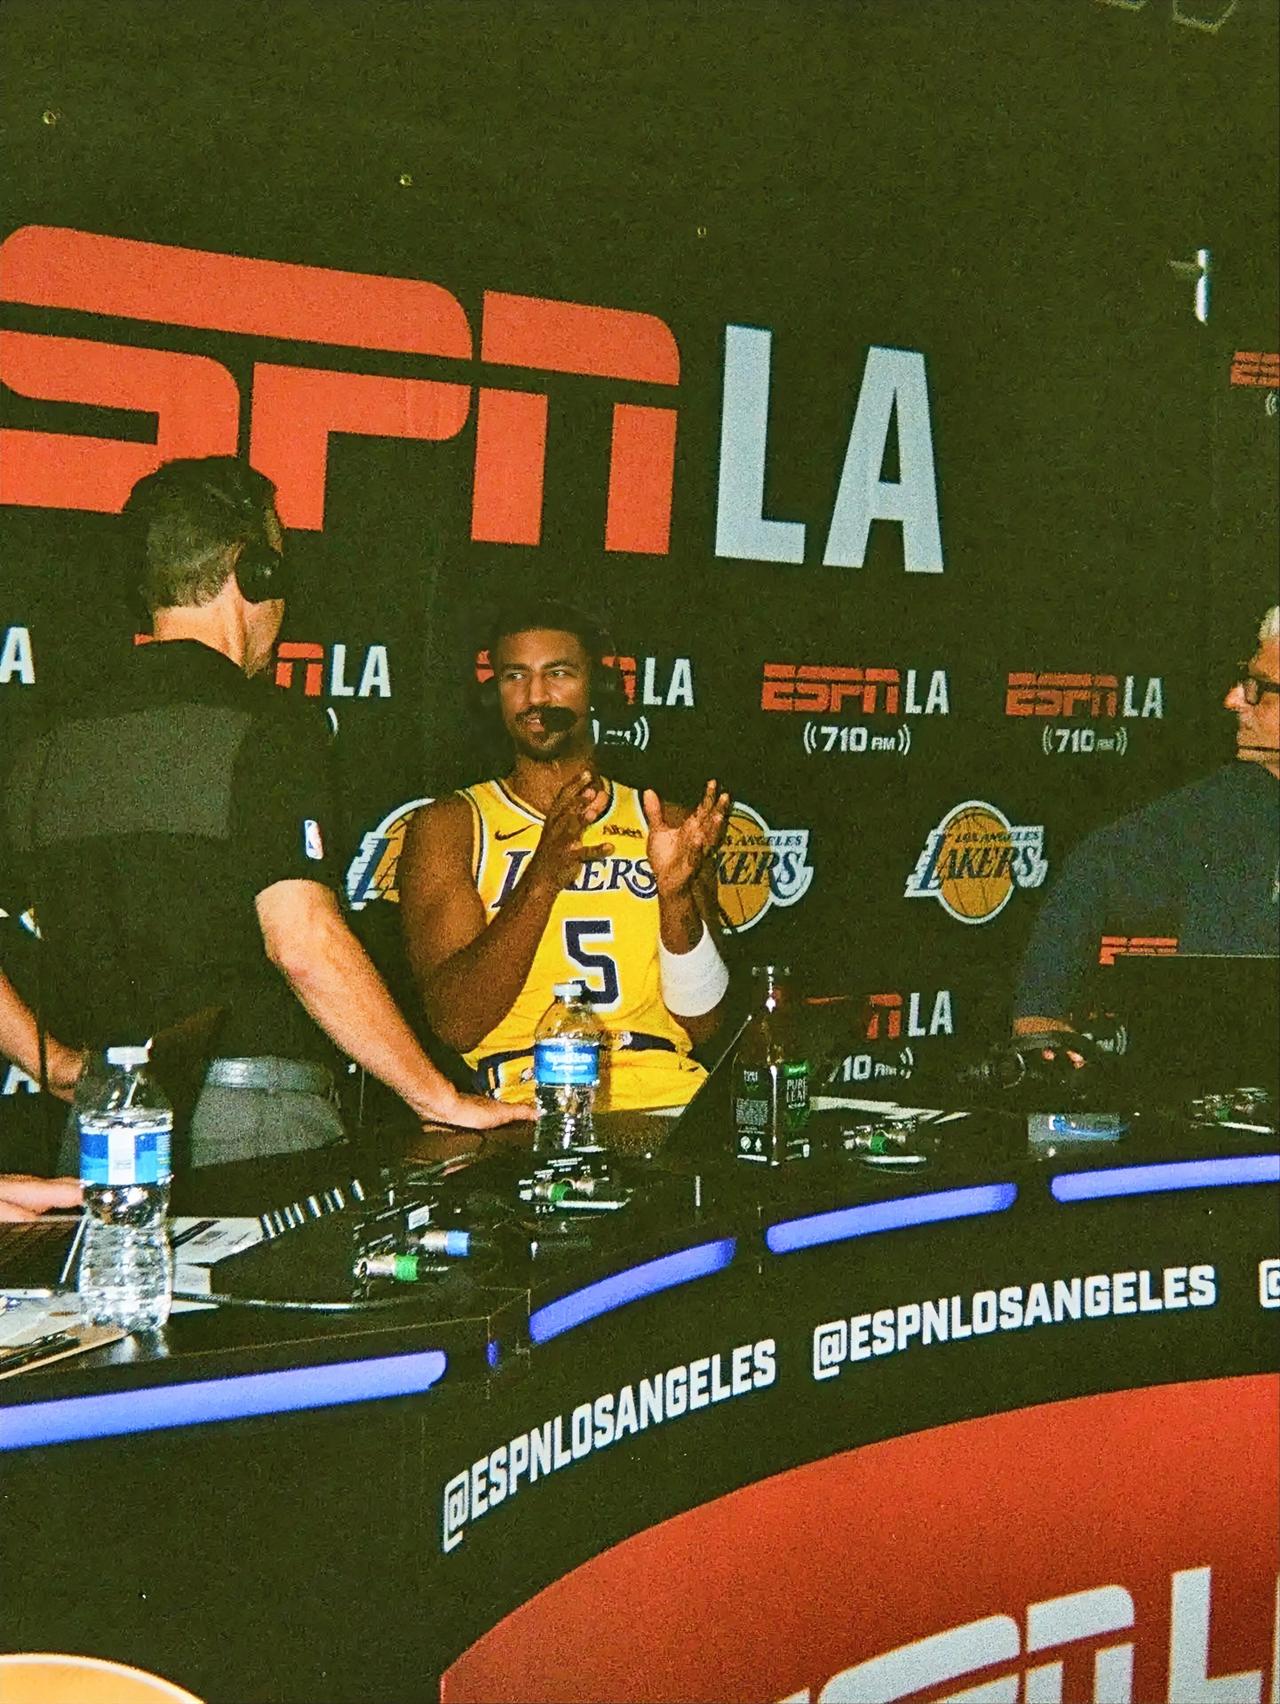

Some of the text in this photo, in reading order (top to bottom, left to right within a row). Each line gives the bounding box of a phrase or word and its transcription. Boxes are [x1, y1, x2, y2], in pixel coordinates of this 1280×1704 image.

[714, 323, 944, 574] LA
[331, 643, 392, 698] LA
[642, 656, 694, 707] LA
[762, 663, 949, 714] ESPN LA
[1006, 672, 1164, 719] ESPN LA
[821, 725, 896, 752] 710 AM
[1055, 727, 1095, 753] 710
[908, 832, 1044, 889] LAKERS
[563, 918, 620, 1006] 5
[907, 988, 953, 1038] LA
[813, 1264, 1216, 1380] @ESPNLOSANGELES
[443, 1338, 776, 1553] @ESPNLOSANGELES
